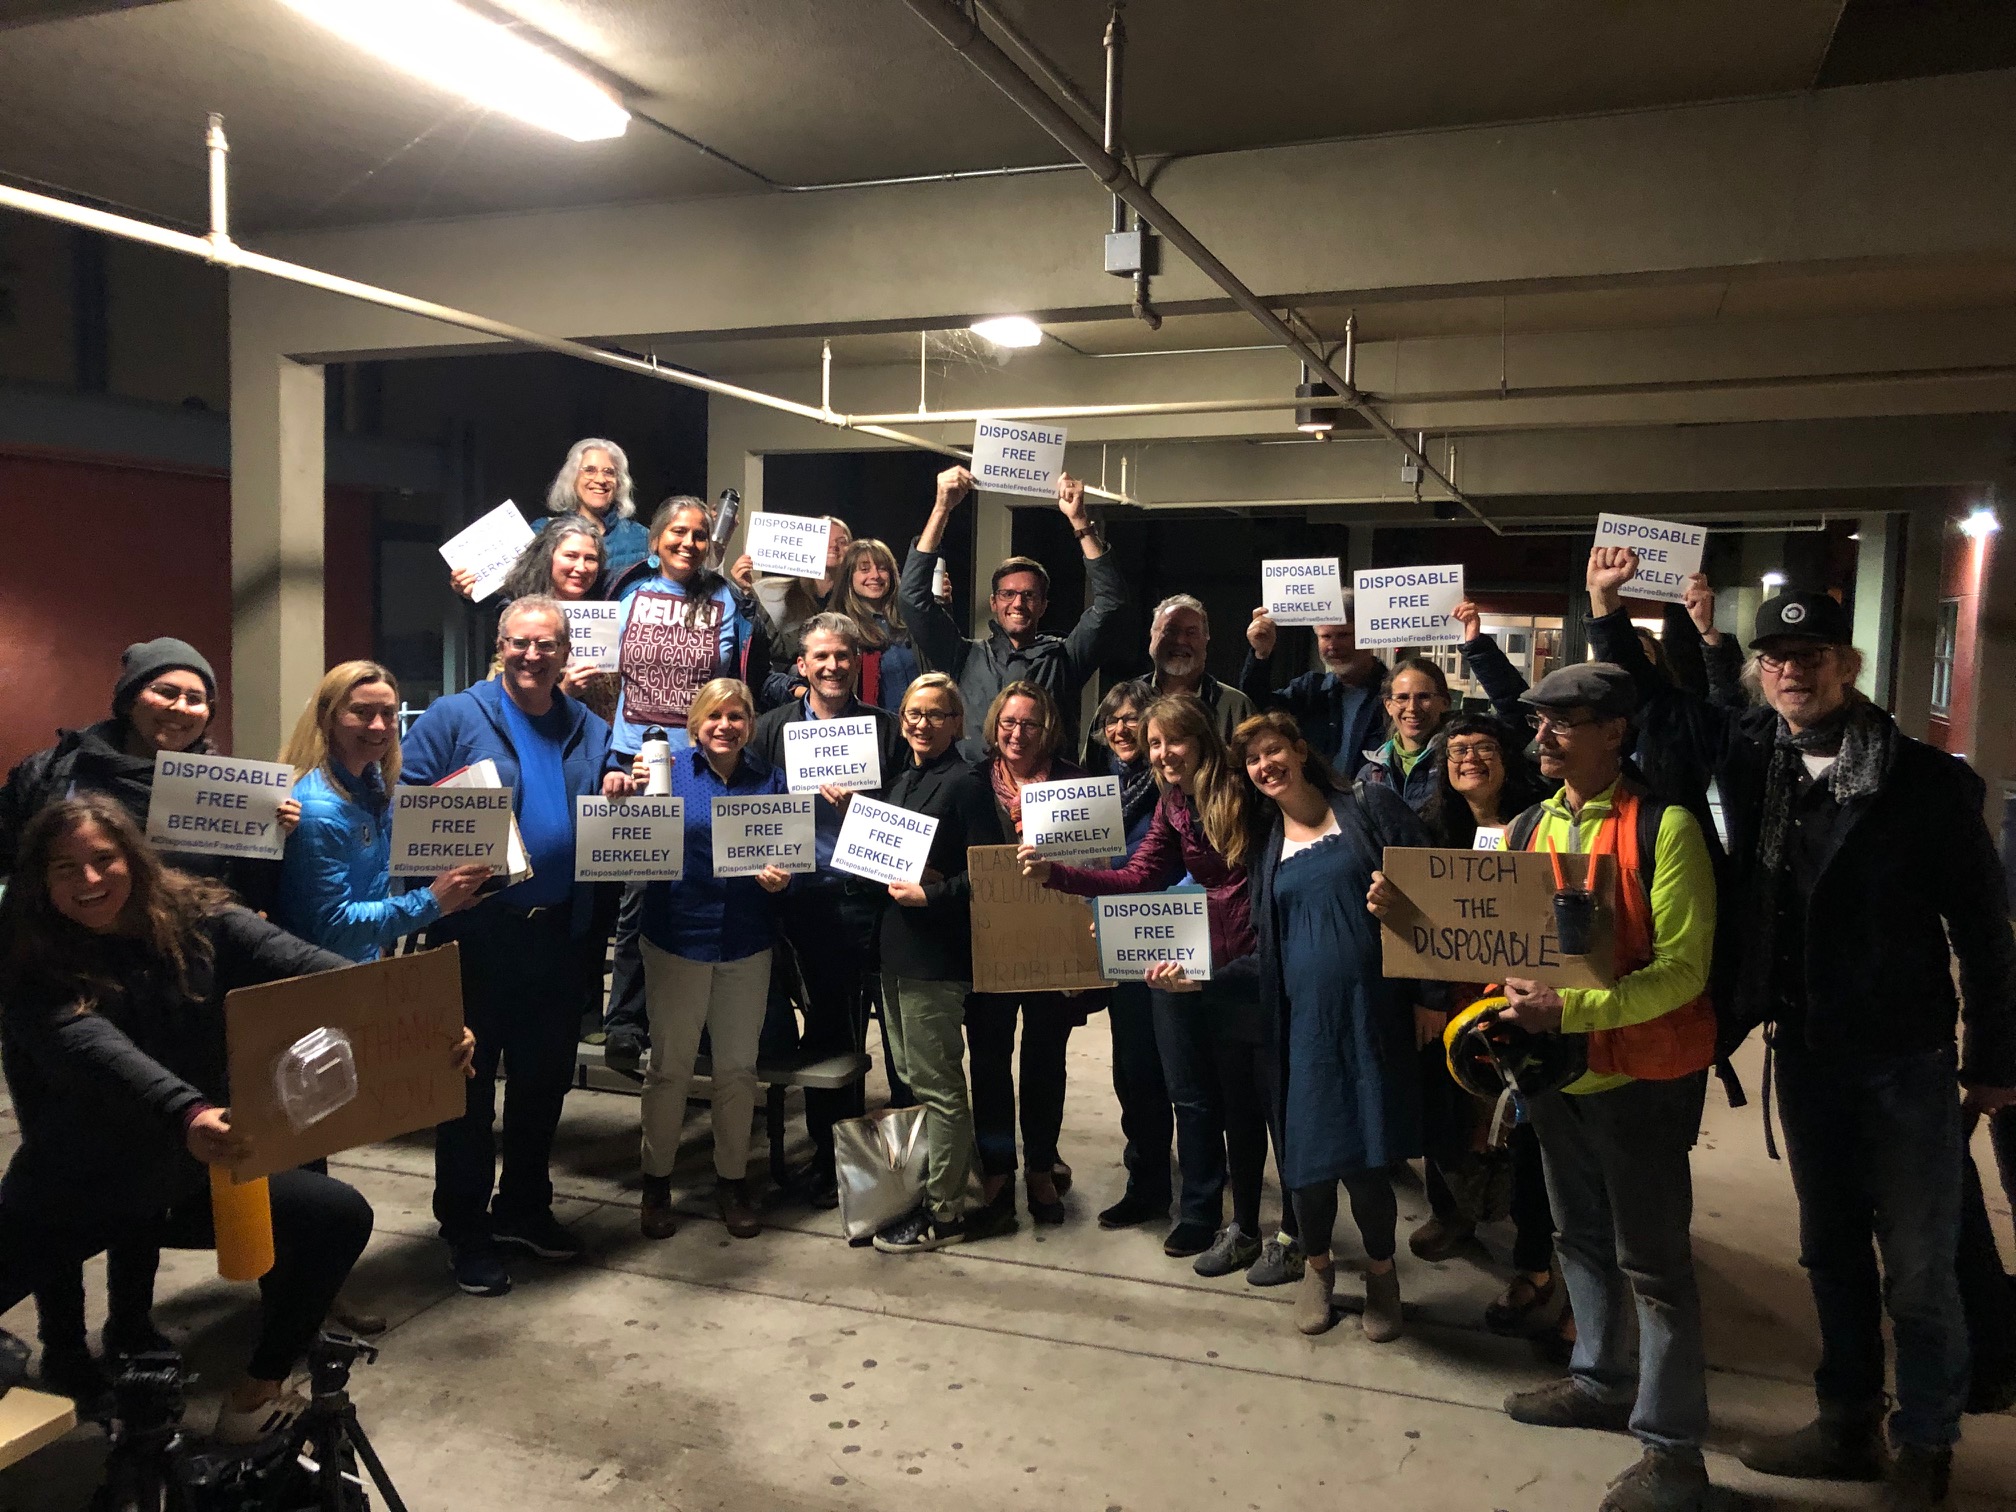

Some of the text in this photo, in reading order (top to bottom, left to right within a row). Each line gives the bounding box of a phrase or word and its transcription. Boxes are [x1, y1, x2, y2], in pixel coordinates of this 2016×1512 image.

[980, 425, 1063, 445] DISPOSABLE
[1002, 447, 1036, 462] FREE
[984, 464, 1050, 481] BERKELEY
[976, 479, 1056, 495] DisposableFreeBerkeley
[754, 517, 827, 535] DISPOSABLE
[1602, 521, 1701, 546] DISPOSABLE
[773, 534, 804, 547] FREE
[757, 548, 816, 564] BERKELEY
[754, 560, 821, 576] isposableFreeBerkeley
[1265, 564, 1336, 577] DISPOSABLE
[1359, 571, 1459, 590] DISPOSABLE
[1634, 568, 1684, 586] KELEY
[1285, 584, 1315, 595] FREE
[1272, 601, 1332, 613] BERKELEY
[1389, 594, 1429, 609] FREE
[564, 608, 617, 619] OSABLE
[1370, 615, 1450, 631] BERKELEY
[569, 627, 592, 638] REE
[626, 622, 714, 649] BECAUSE
[1359, 633, 1461, 645] #DisposableFreeBerkeley
[569, 646, 607, 657] KELEY
[624, 643, 714, 668] YOU CAN'T
[623, 662, 711, 691] RECYCLE
[626, 685, 698, 707] THE PLANE
[788, 723, 873, 741] DISPOSABLE
[814, 745, 849, 758] FREE
[161, 760, 288, 788] DISPOSABLE
[799, 762, 867, 778] BERKELEY
[791, 779, 878, 792] #DisposFreeBerkeley
[196, 790, 249, 810] FREE
[400, 794, 508, 810] DISPOSABLE
[1025, 784, 1116, 804] DISPOSABLE
[582, 804, 680, 818] DISPOSABLE
[716, 801, 811, 817] DISPOSABLE
[1051, 808, 1090, 822] FREE
[168, 814, 270, 836] BERKELEY
[431, 819, 476, 833] FREE
[852, 802, 933, 836] DISPOSABLE
[612, 827, 652, 840] FREE
[745, 823, 783, 837] FREE
[1035, 827, 1110, 845] BERKELEY
[868, 828, 903, 849] FREE
[408, 843, 494, 857] BERKELEY
[592, 849, 671, 862] BERKELEY
[727, 843, 802, 859] BERKELEY
[847, 843, 914, 872] BERKELEY
[580, 868, 679, 878] #DisposableFreeBerkeley
[718, 861, 812, 873] #DisposableFeBerkeley
[1429, 855, 1518, 884] DITCH
[1104, 902, 1203, 917] DISPOSABLE
[1453, 897, 1499, 919] THE
[1134, 925, 1175, 939] FREE
[1117, 948, 1195, 961] BERKELEY
[1413, 925, 1560, 968] DISPOSABLE
